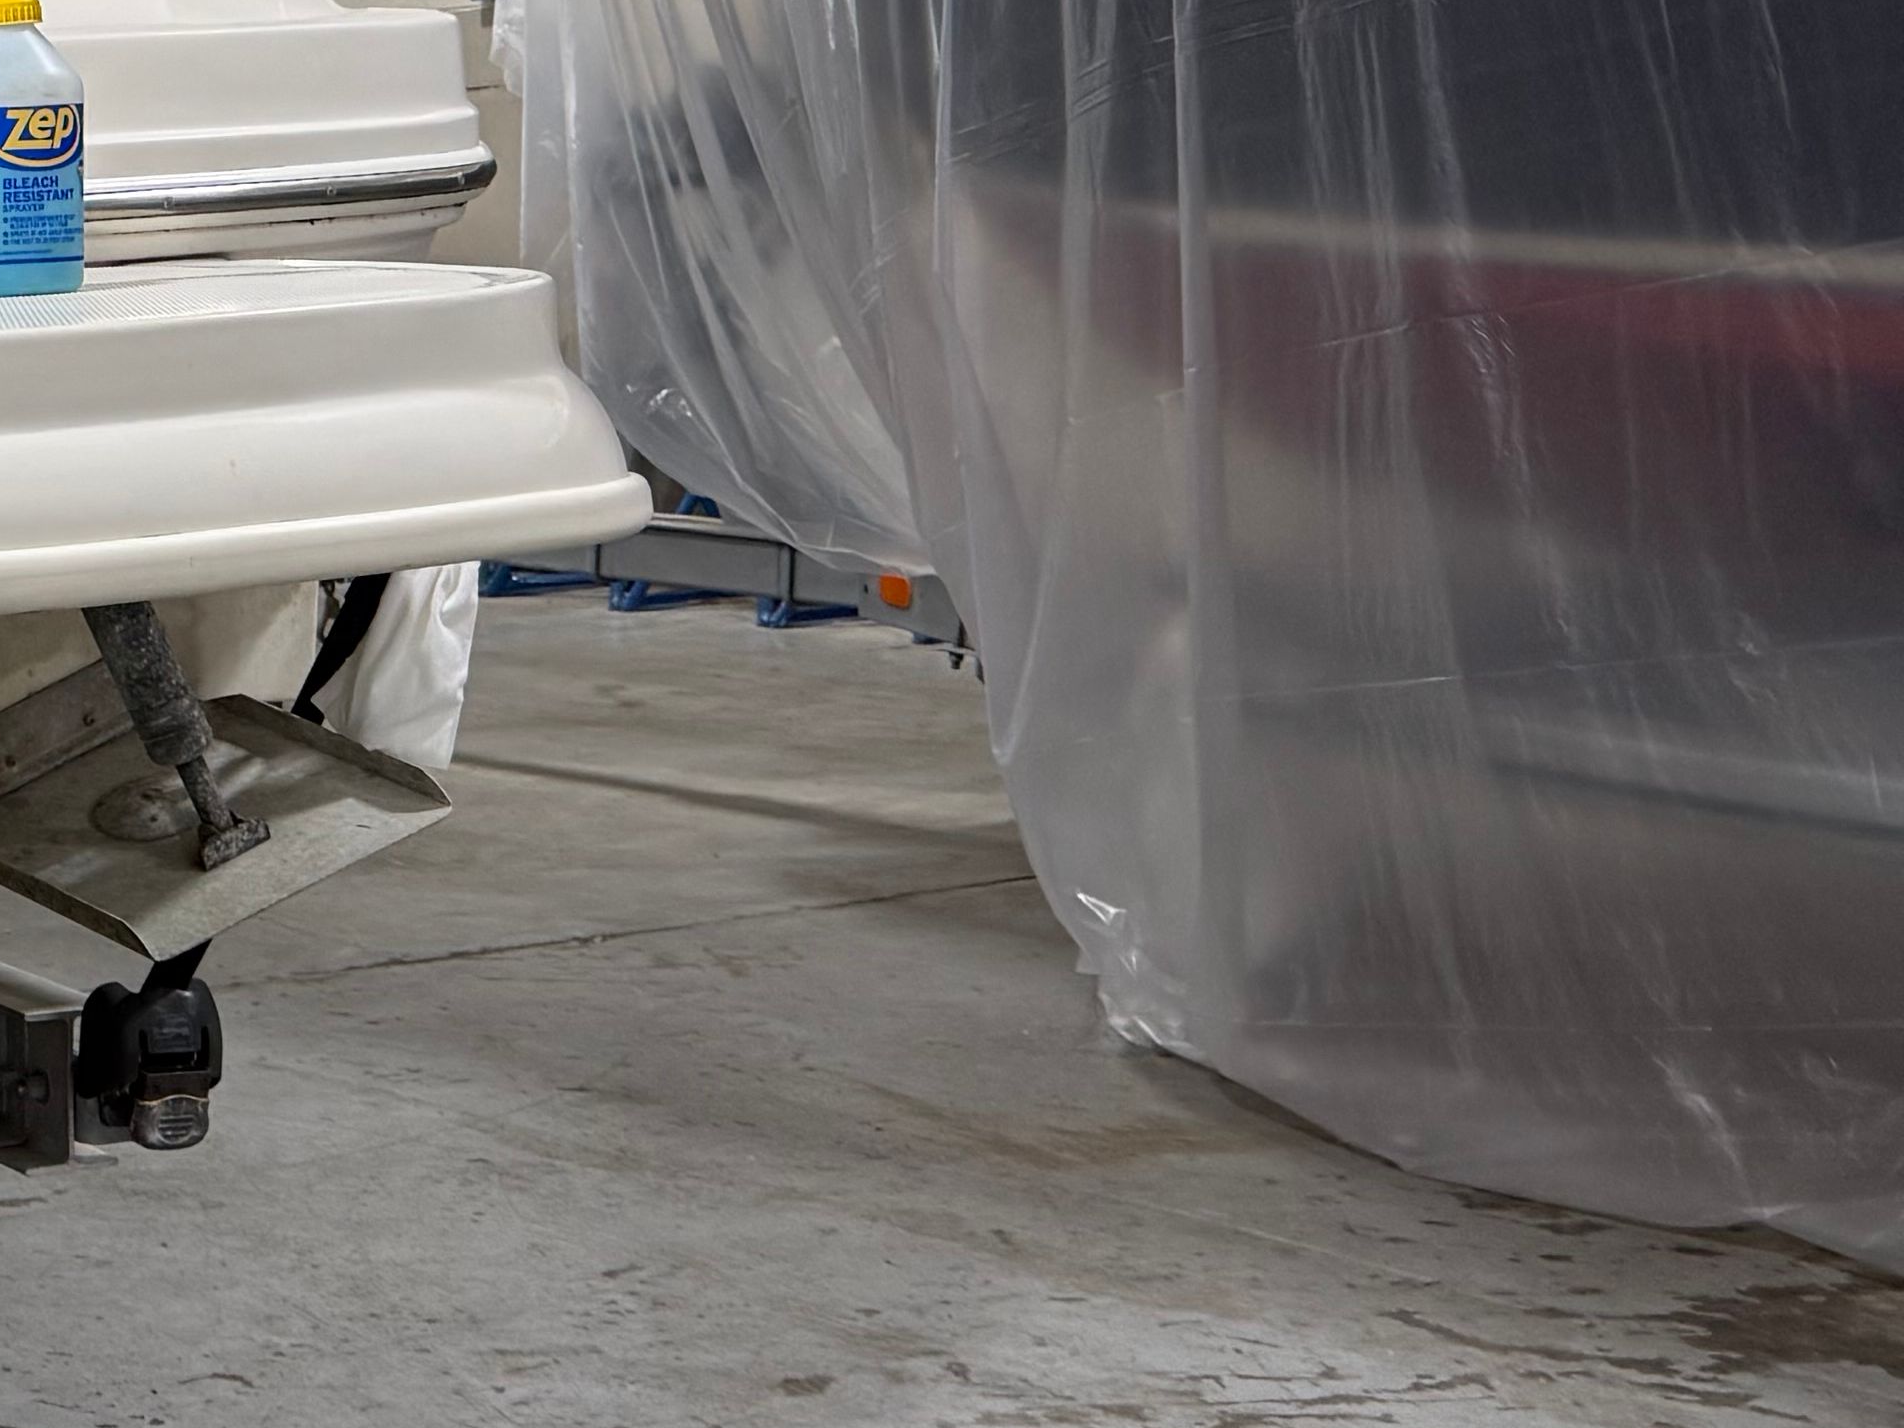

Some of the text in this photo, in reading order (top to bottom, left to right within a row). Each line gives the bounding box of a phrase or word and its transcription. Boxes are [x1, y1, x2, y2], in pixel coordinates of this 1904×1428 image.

[3, 176, 59, 190] BLEACH
[3, 188, 75, 203] RESISTANT
[3, 203, 45, 213] SPRAYER
